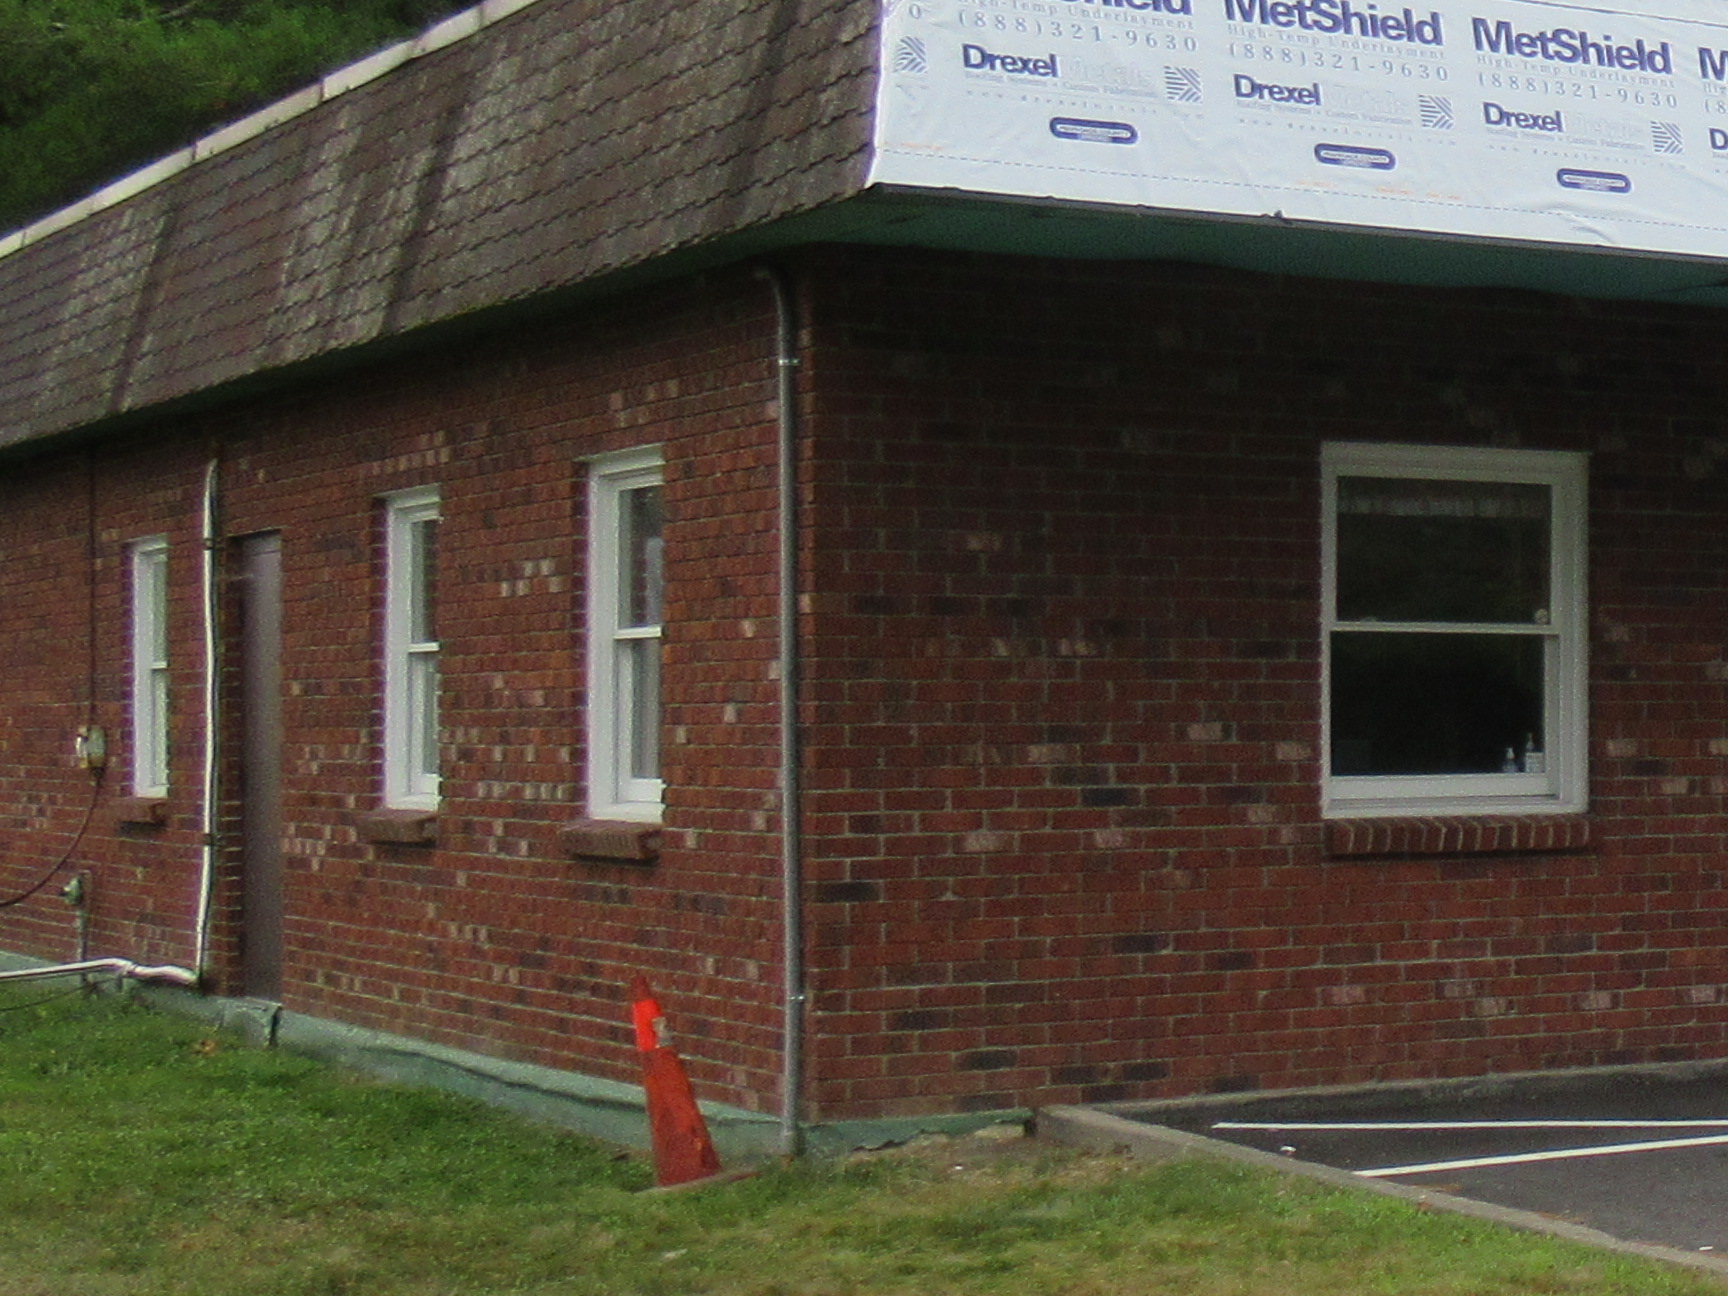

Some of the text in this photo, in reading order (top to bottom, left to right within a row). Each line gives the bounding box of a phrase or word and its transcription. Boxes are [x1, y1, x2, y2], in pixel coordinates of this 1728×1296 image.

[958, 8, 1197, 56] (888)321-9630
[1471, 17, 1673, 75] MetShield
[961, 43, 1058, 78] Drexel
[1230, 40, 1450, 85] (888)321-9630
[1233, 73, 1321, 106] Drexel
[1479, 70, 1679, 111] (888)321-9630
[1482, 101, 1563, 133] Drexel
